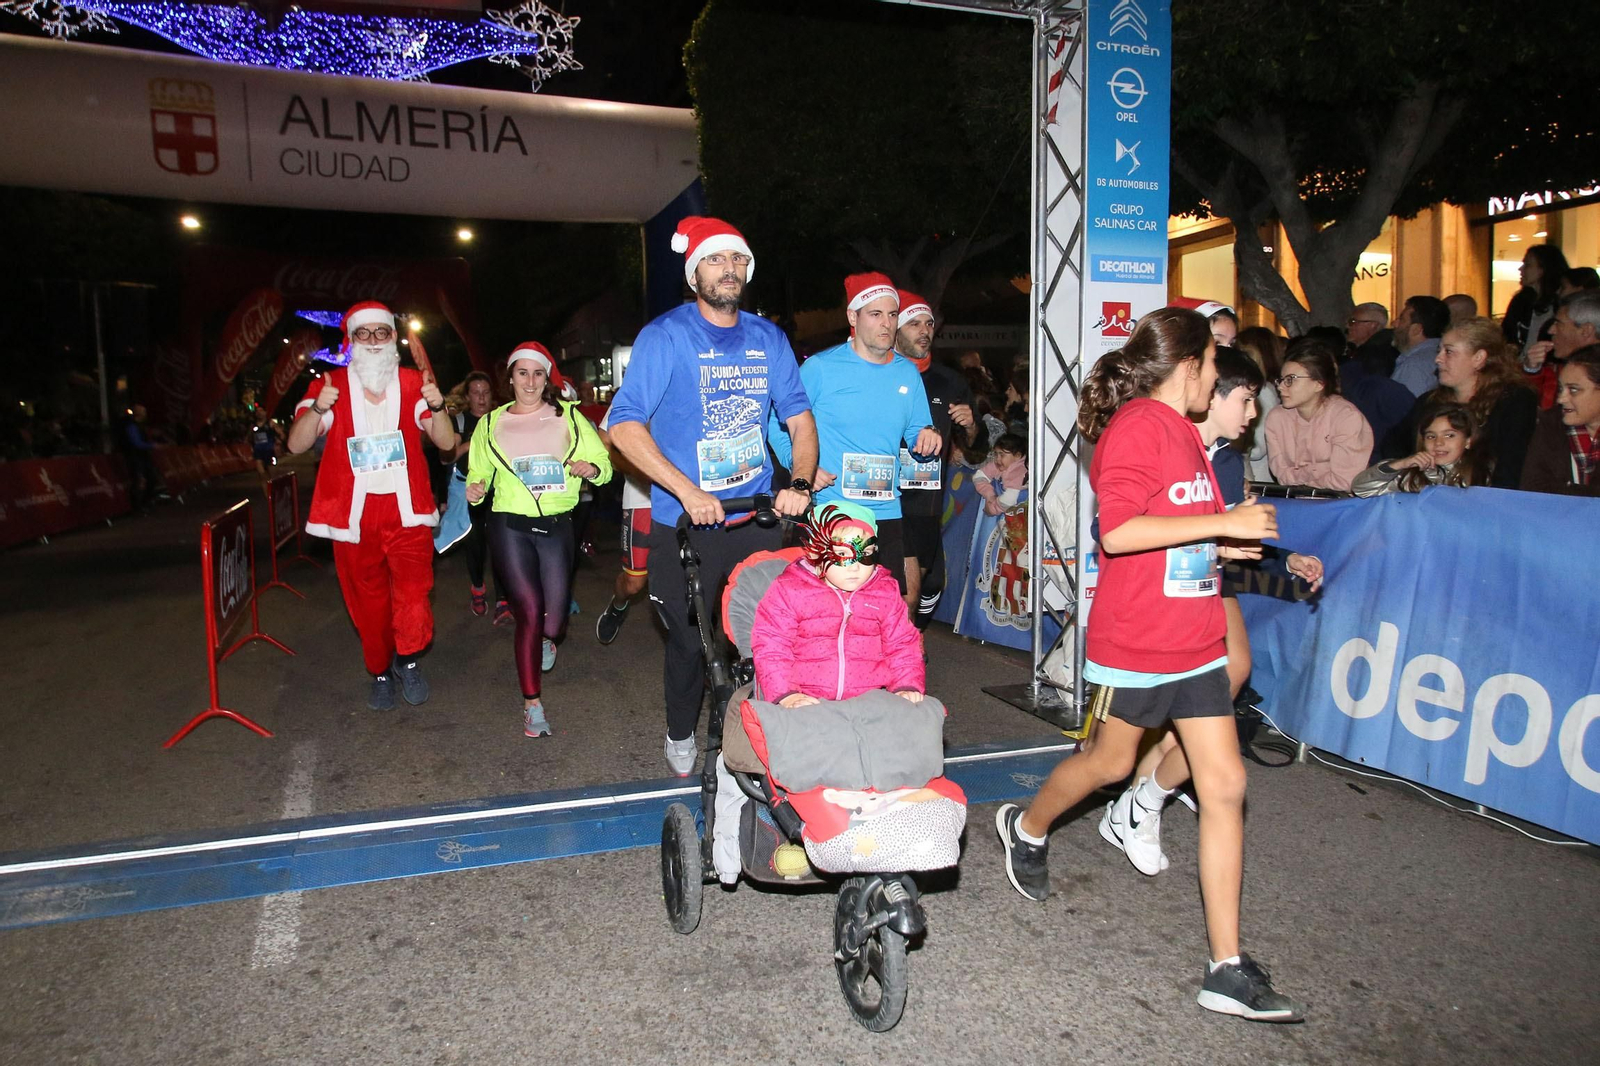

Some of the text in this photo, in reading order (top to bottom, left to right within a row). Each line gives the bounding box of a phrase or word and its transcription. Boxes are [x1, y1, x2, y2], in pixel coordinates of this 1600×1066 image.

[1095, 40, 1161, 57] CITROËN
[1116, 111, 1138, 123] OPEL
[279, 93, 529, 156] ALMERÍA
[279, 147, 410, 183] CIUDAD
[1096, 177, 1159, 191] DS AUTOMOBILES
[1109, 203, 1144, 216] GRUPO
[1094, 217, 1157, 232] SALINAS CAR
[1099, 260, 1156, 274] DECATHLON
[699, 365, 711, 387] XIV
[711, 365, 742, 379] SUBIDA
[729, 377, 768, 390] CONJURO
[728, 442, 761, 466] 1509
[532, 464, 561, 476] 2011
[912, 461, 939, 472] 1355
[867, 467, 893, 481] 1353
